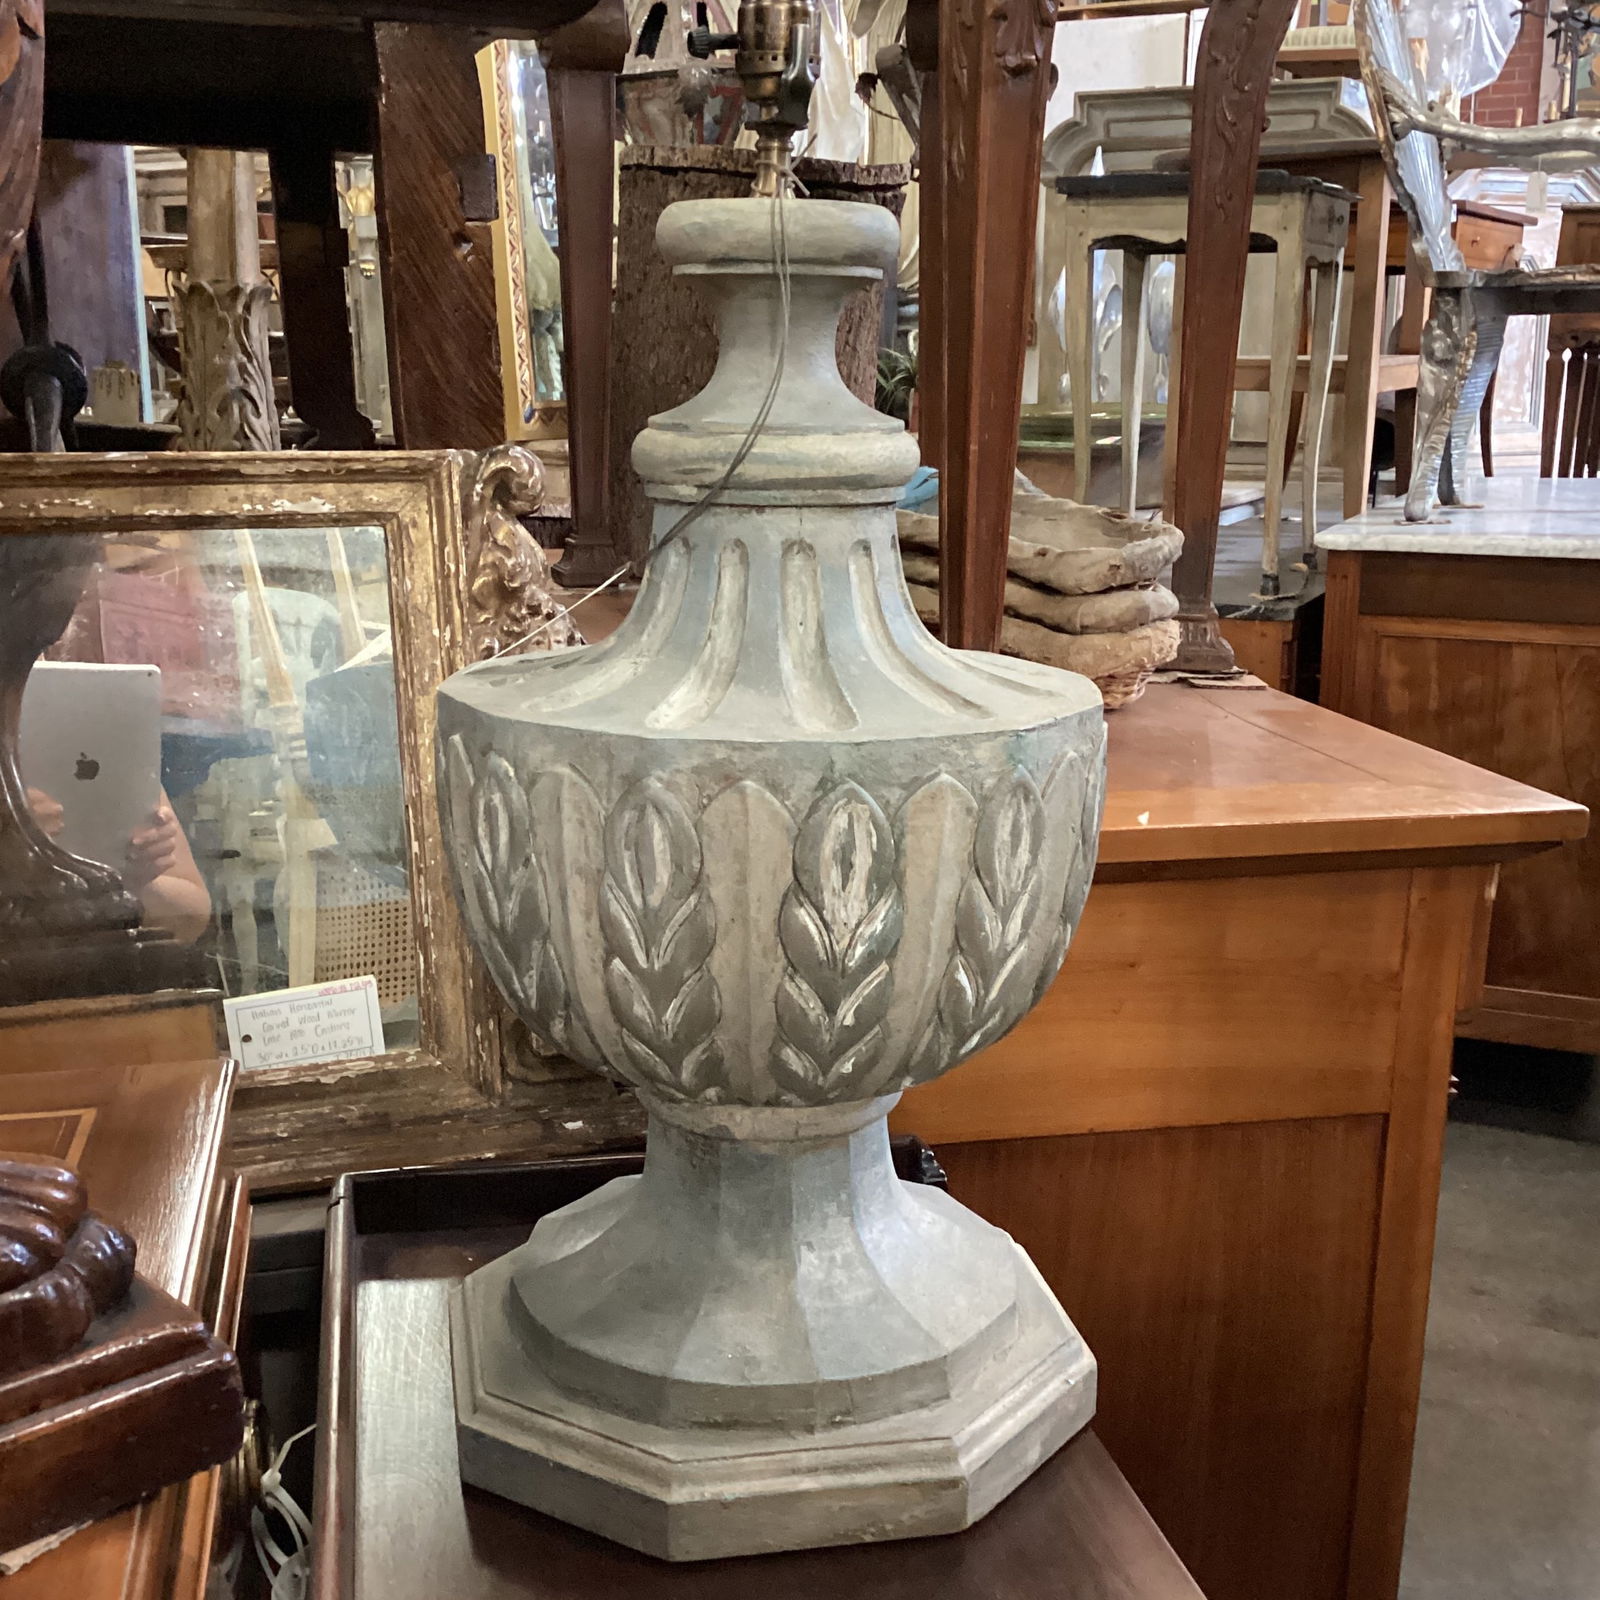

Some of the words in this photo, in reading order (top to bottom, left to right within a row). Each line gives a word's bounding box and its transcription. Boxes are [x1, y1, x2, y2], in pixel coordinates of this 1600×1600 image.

[290, 998, 333, 1014] Horizontal
[298, 1013, 320, 1026] Wood
[327, 1008, 357, 1019] Mirror
